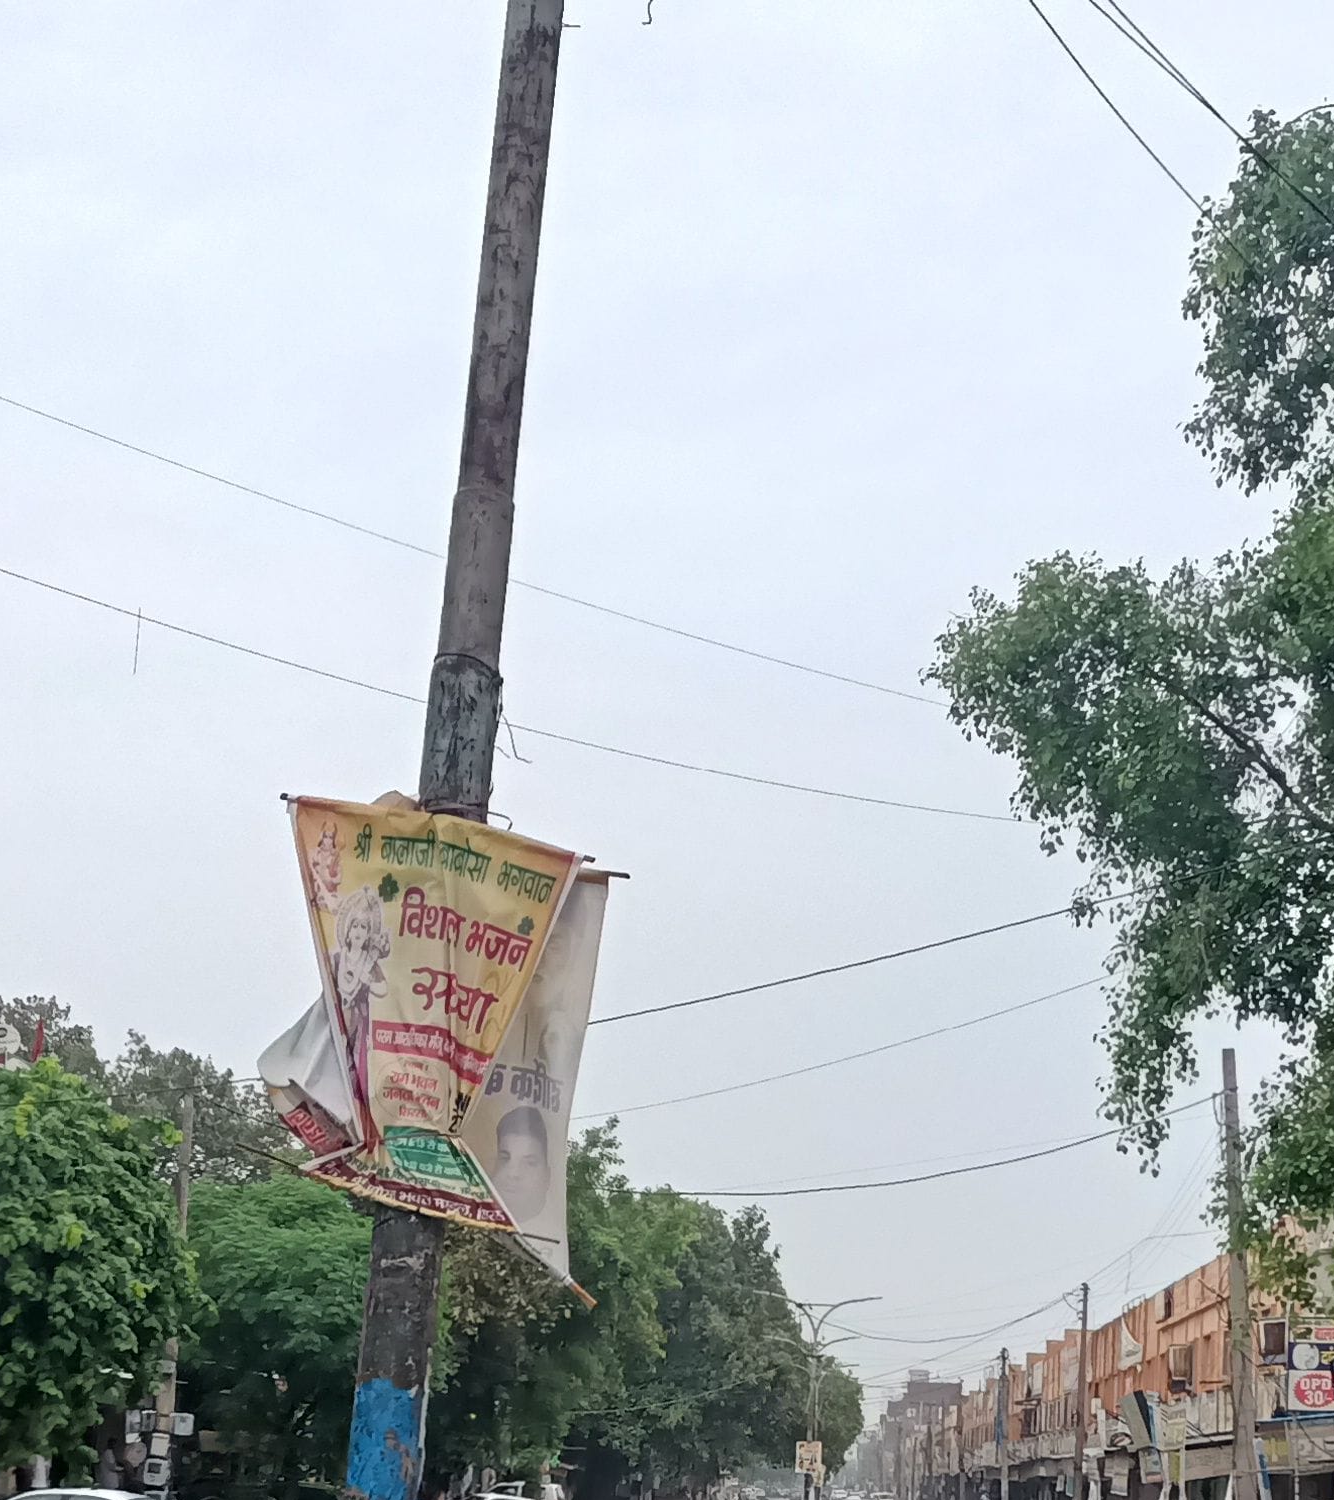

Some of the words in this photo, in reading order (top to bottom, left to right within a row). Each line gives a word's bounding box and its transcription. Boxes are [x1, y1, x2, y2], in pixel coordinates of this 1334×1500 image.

[354, 823, 372, 863] श्री
[381, 829, 436, 867] बालाजी
[497, 860, 556, 904] भगवान
[465, 920, 533, 972] भजन
[1299, 1377, 1332, 1391] OPD
